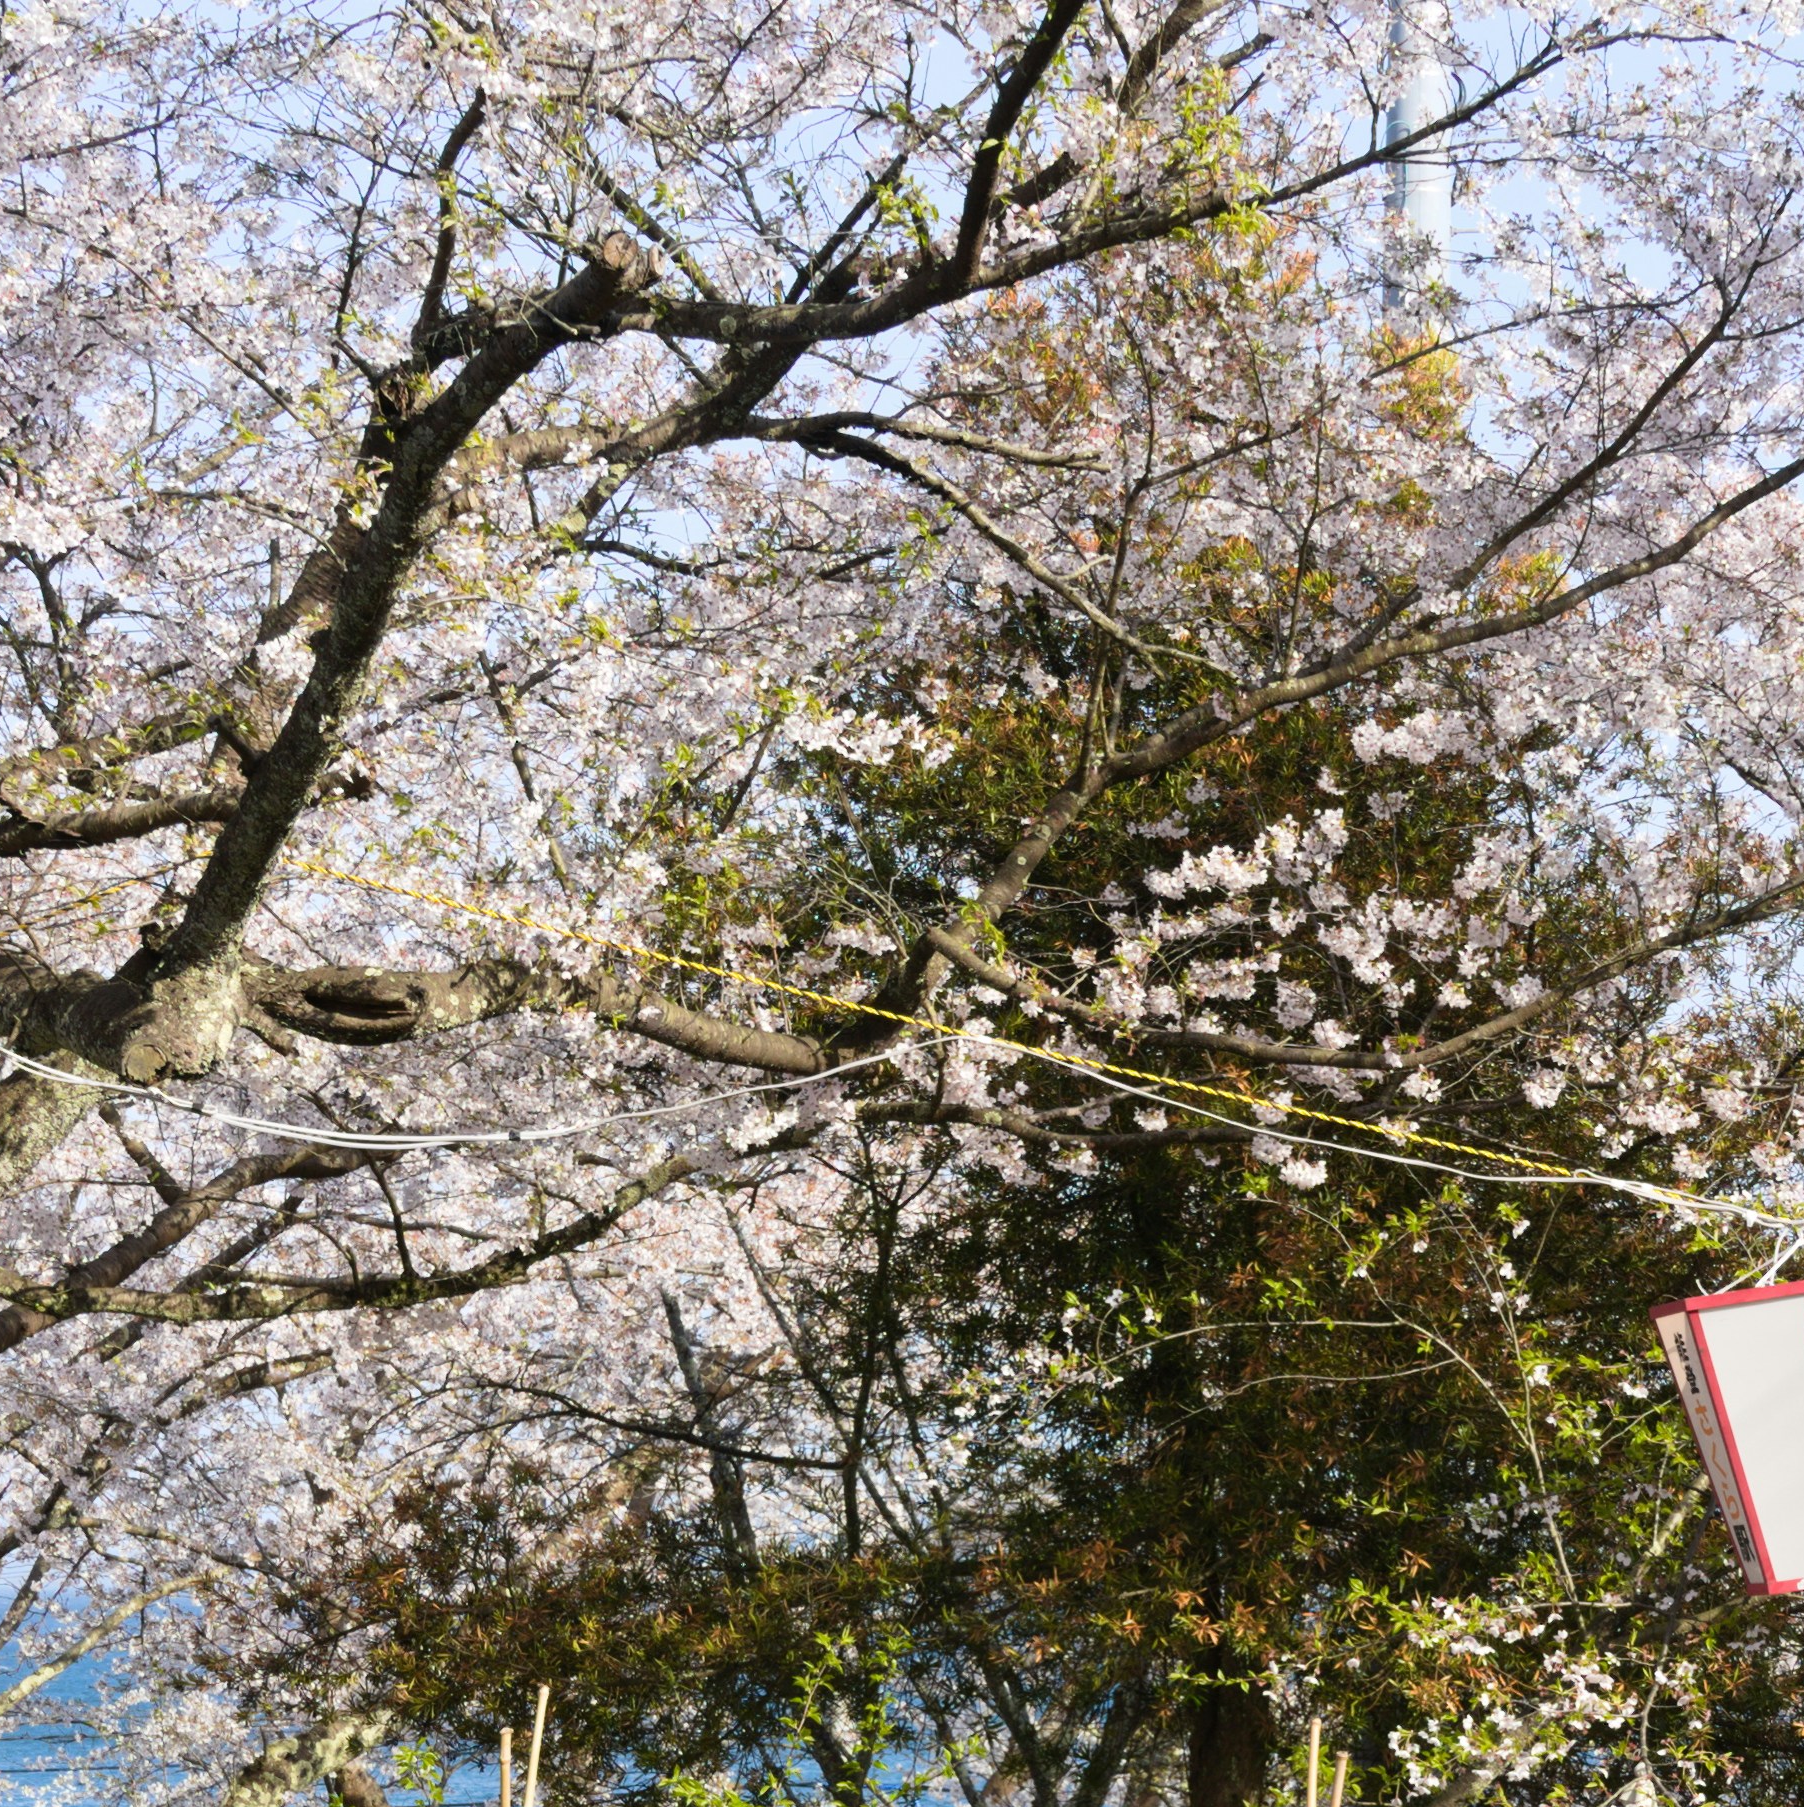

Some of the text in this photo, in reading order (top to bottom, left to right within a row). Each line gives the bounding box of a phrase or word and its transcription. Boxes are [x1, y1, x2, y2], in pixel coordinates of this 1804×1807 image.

[1673, 1331, 1757, 1564] 能登さくら駅
